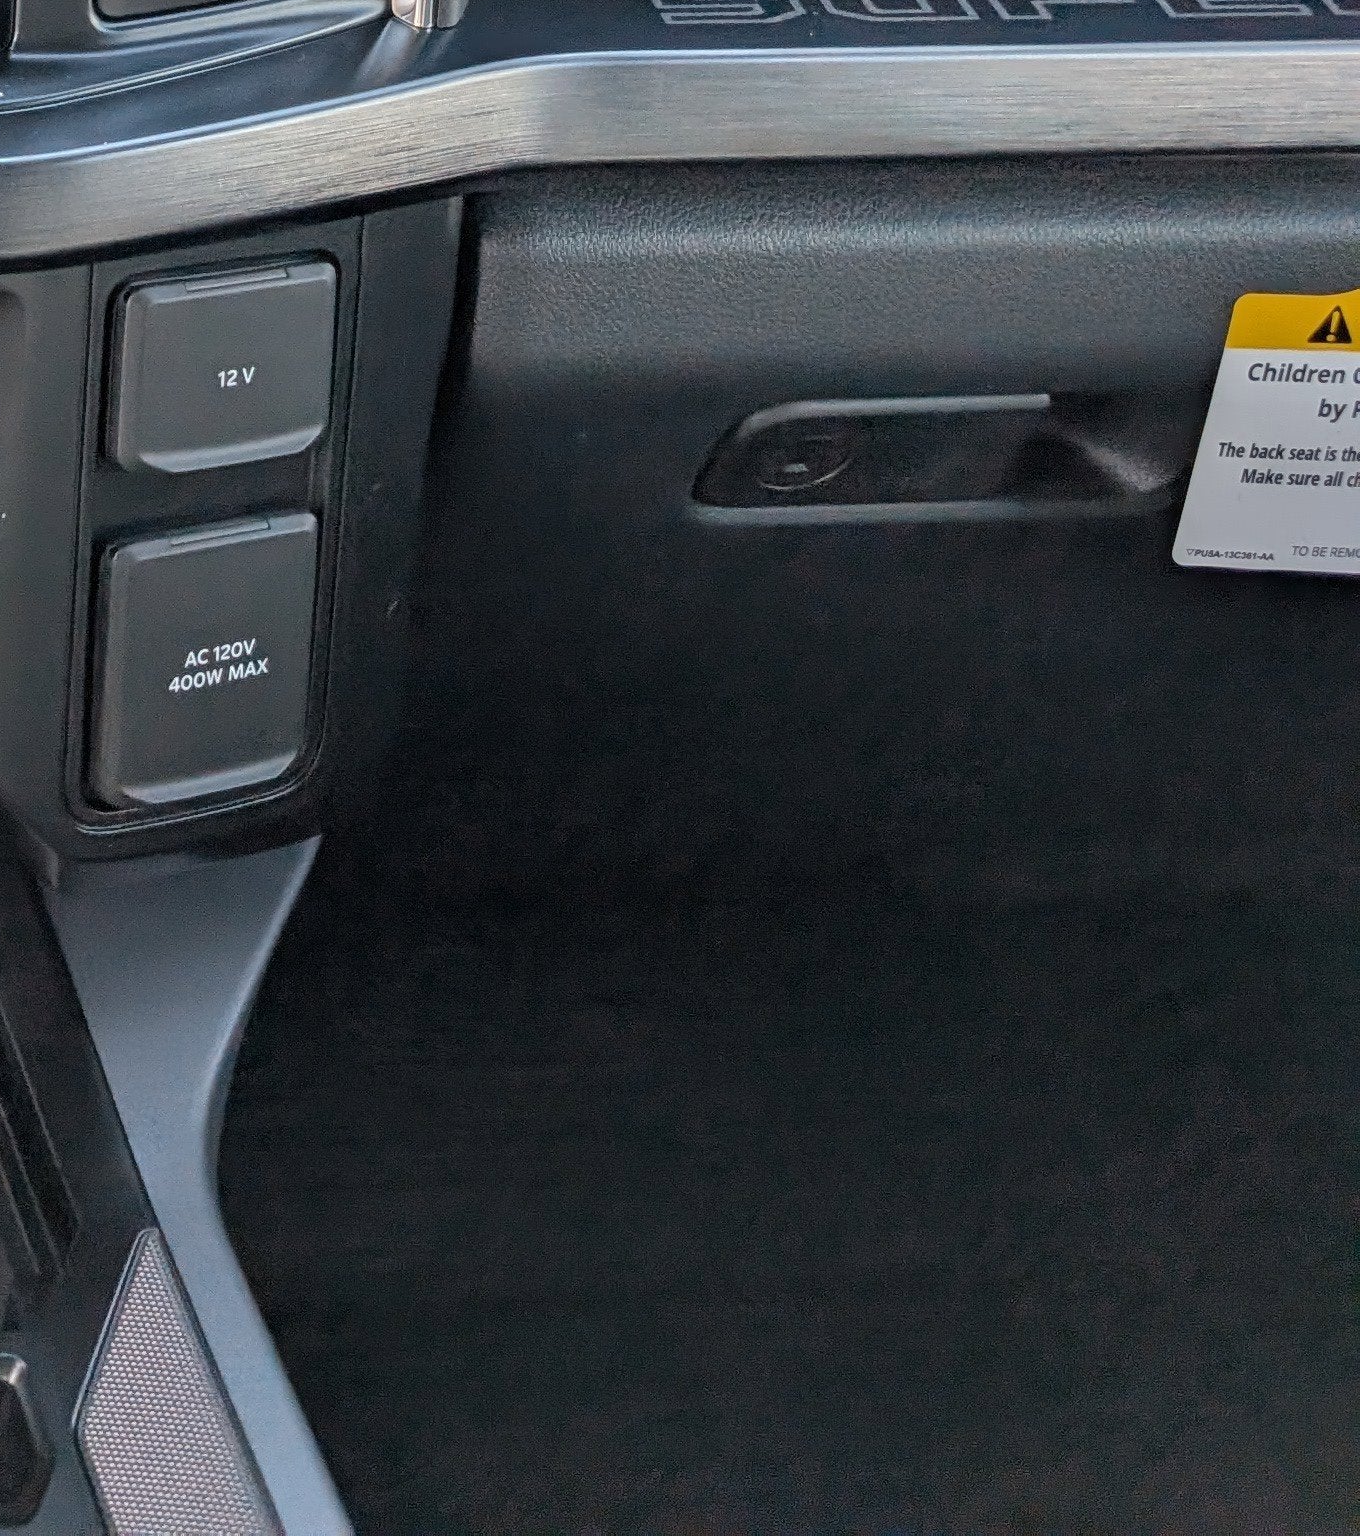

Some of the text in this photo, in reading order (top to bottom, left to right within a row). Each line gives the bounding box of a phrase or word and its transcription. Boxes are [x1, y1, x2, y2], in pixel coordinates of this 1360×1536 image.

[218, 367, 255, 387] 12 V
[1249, 363, 1345, 383] Children
[1317, 398, 1347, 424] by
[1218, 441, 1246, 459] The
[1250, 444, 1285, 459] back
[1287, 447, 1322, 461] seat
[1325, 447, 1337, 461] is
[1240, 468, 1284, 485] Make
[1286, 473, 1321, 486] sure
[1324, 472, 1344, 486] all
[1293, 546, 1309, 556] TO
[1312, 547, 1327, 557] BE
[185, 638, 256, 667] AC 120V
[168, 657, 269, 693] 400W MAX
